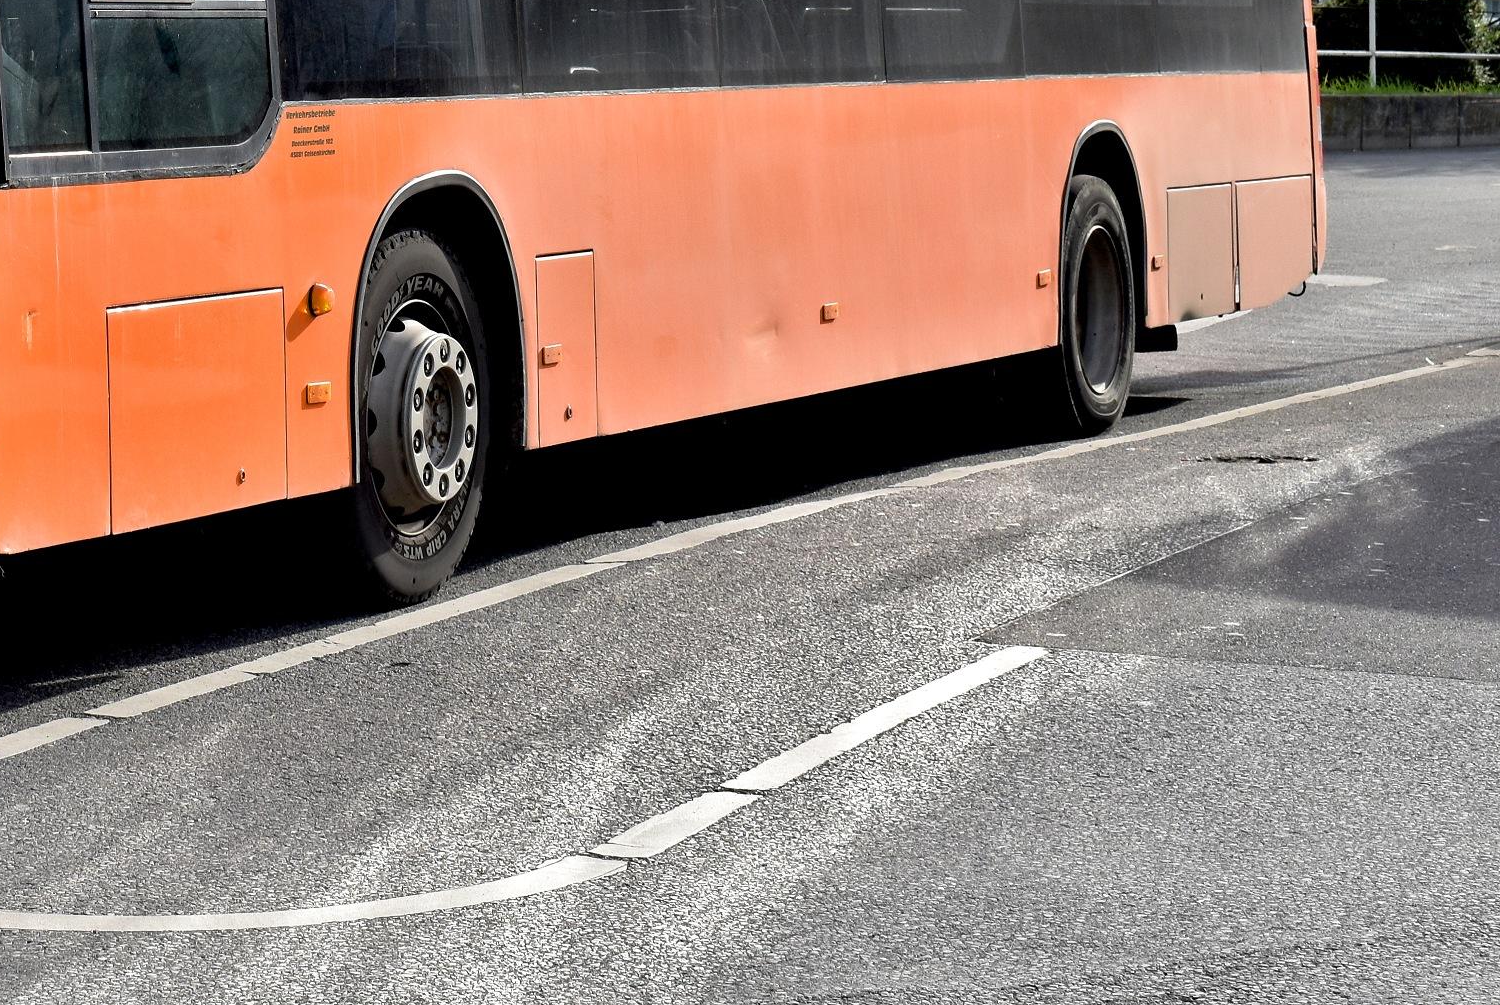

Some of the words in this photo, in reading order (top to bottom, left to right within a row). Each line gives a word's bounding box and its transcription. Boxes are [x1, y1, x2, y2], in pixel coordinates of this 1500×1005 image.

[286, 109, 336, 119] Verkehrsbetriebe
[293, 125, 312, 134] Rainer
[314, 124, 331, 133] GmbH
